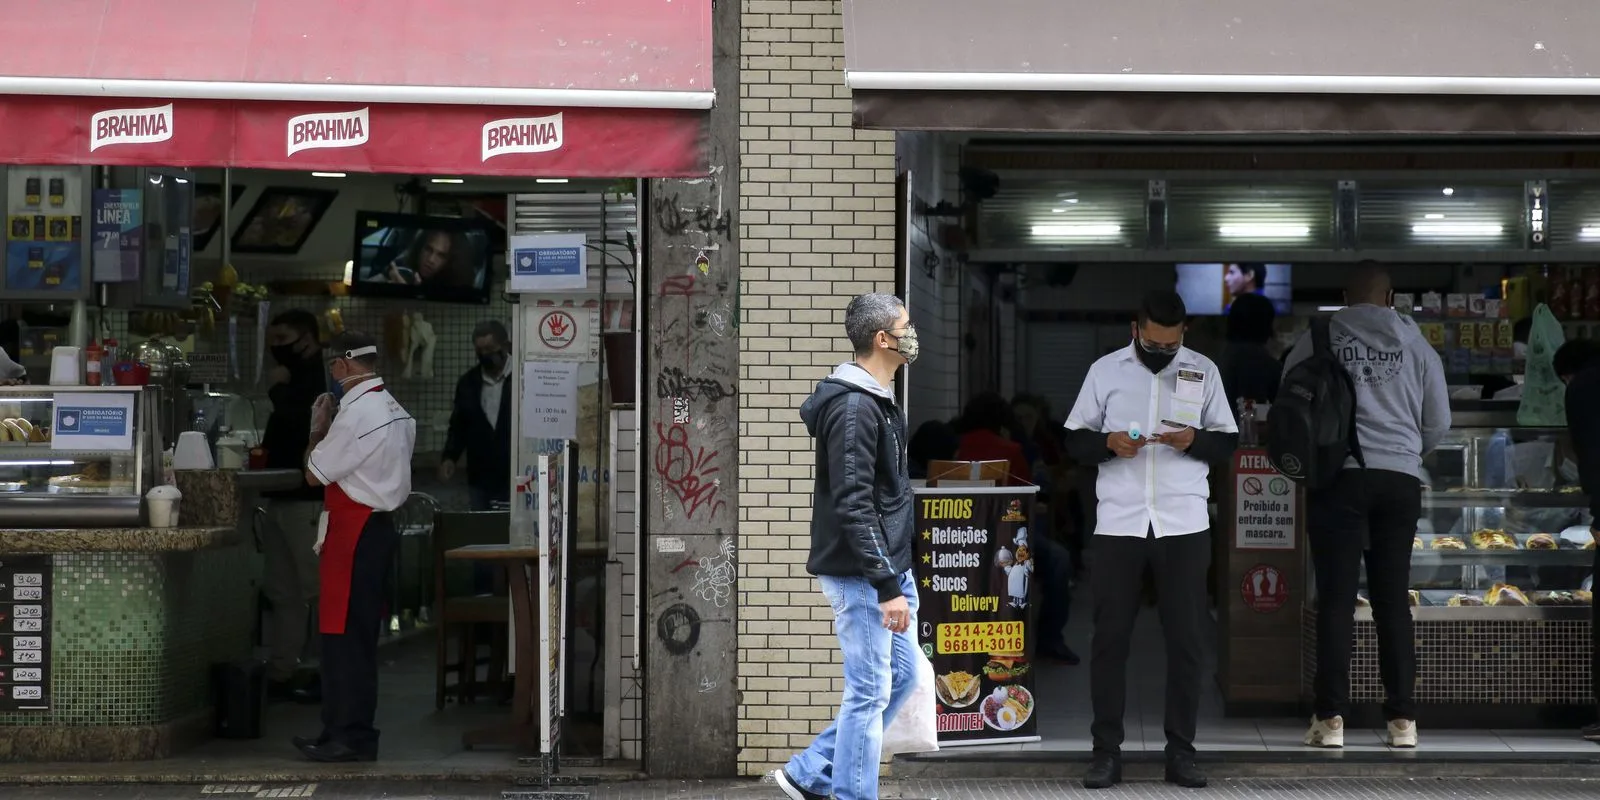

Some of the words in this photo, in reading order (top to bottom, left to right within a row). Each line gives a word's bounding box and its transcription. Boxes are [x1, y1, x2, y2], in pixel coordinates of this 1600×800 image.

[97, 113, 168, 140] BRAHMA
[293, 117, 364, 145] BRAHMA
[488, 122, 558, 150] BRAHMA
[97, 209, 131, 225] LINEA
[1532, 187, 1544, 243] VINHO
[1240, 455, 1277, 472] ATEN
[922, 499, 973, 519] TEMOS
[1243, 500, 1281, 512] Proibido
[1283, 502, 1289, 512] a
[1238, 515, 1273, 525] entrada
[1275, 517, 1293, 525] sem
[932, 527, 988, 547] Refeições
[932, 551, 980, 568] Lanches
[932, 574, 968, 592] Sucos
[951, 594, 1000, 612] Delivery
[944, 623, 1021, 637] 3214-2401
[944, 638, 1022, 652] 96811-3016
[936, 713, 984, 732] ARMITEX
